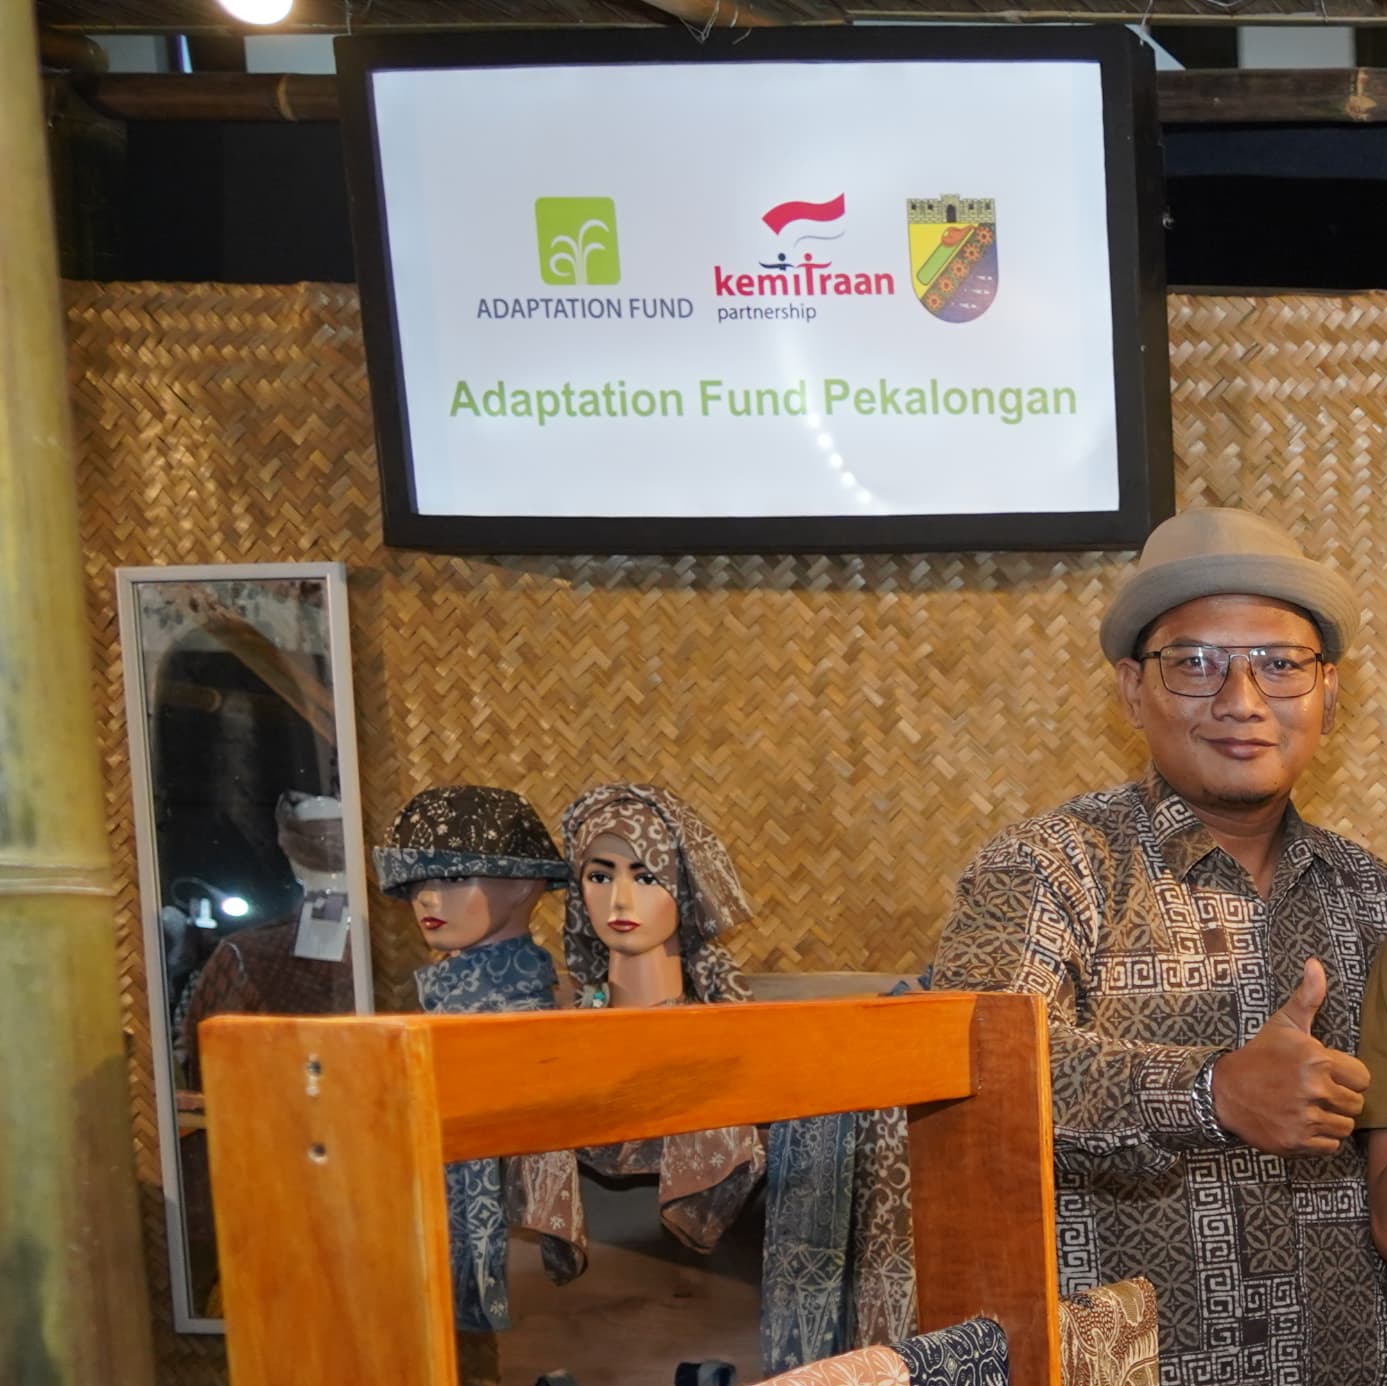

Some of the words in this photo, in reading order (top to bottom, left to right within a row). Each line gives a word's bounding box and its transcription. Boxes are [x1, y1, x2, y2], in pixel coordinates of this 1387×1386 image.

[477, 298, 622, 319] ADAPTATION
[629, 298, 694, 319] FUND
[717, 304, 817, 324] partnership
[450, 380, 684, 426] Adaptation
[699, 380, 808, 417] Fund
[823, 378, 1077, 425] Pekalongan
